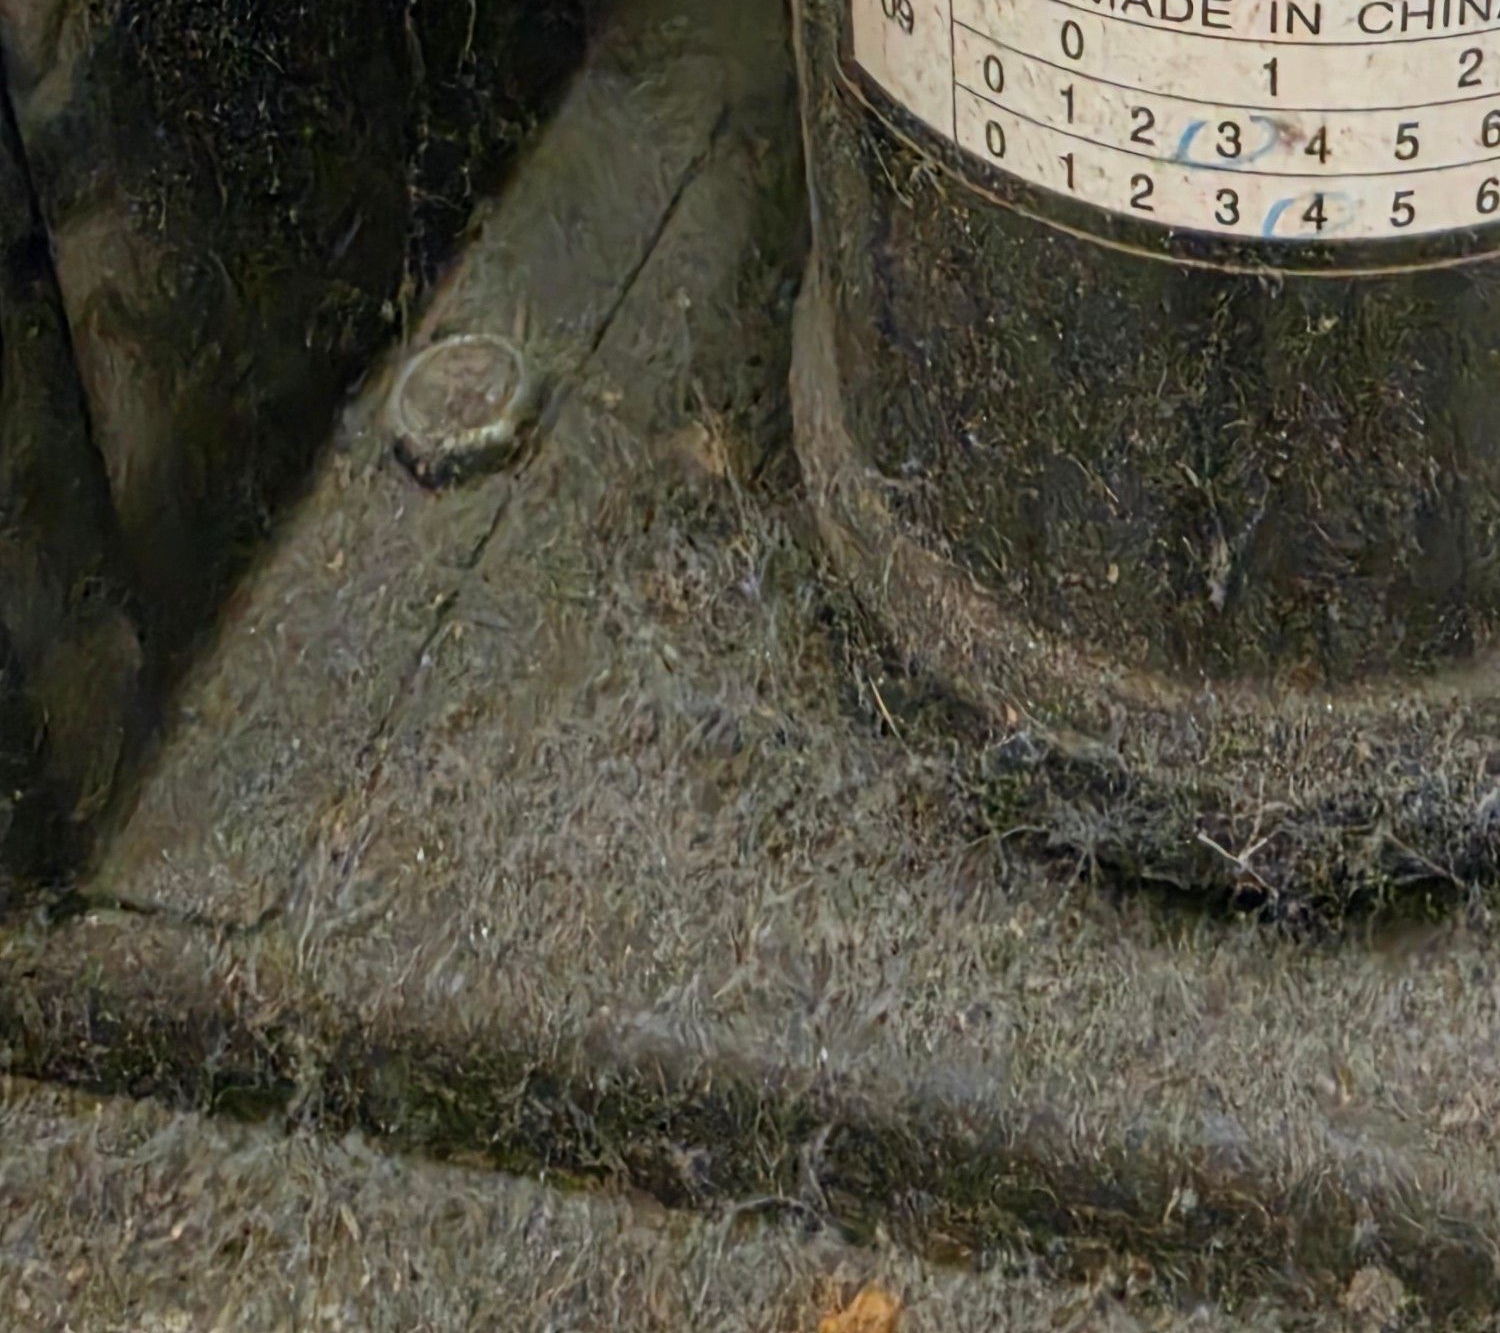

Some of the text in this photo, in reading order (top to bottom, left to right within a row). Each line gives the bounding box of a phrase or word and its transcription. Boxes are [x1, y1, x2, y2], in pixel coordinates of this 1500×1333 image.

[1060, 20, 1084, 61] 0
[1263, 57, 1279, 97] 1
[1457, 47, 1484, 88] 2
[1270, 0, 1321, 35] IN
[983, 54, 1004, 94] 0
[1060, 83, 1074, 124] 1
[1130, 107, 1156, 147] 2
[1215, 120, 1242, 160] 3
[1304, 125, 1331, 164] 4
[1395, 121, 1420, 161] 5
[985, 119, 1006, 159] 0
[1060, 152, 1075, 191] 1
[1130, 174, 1155, 212] 2
[1214, 188, 1240, 227] 3
[1302, 192, 1328, 231] 4
[1390, 189, 1416, 228] 5
[1476, 177, 1500, 215] 6
